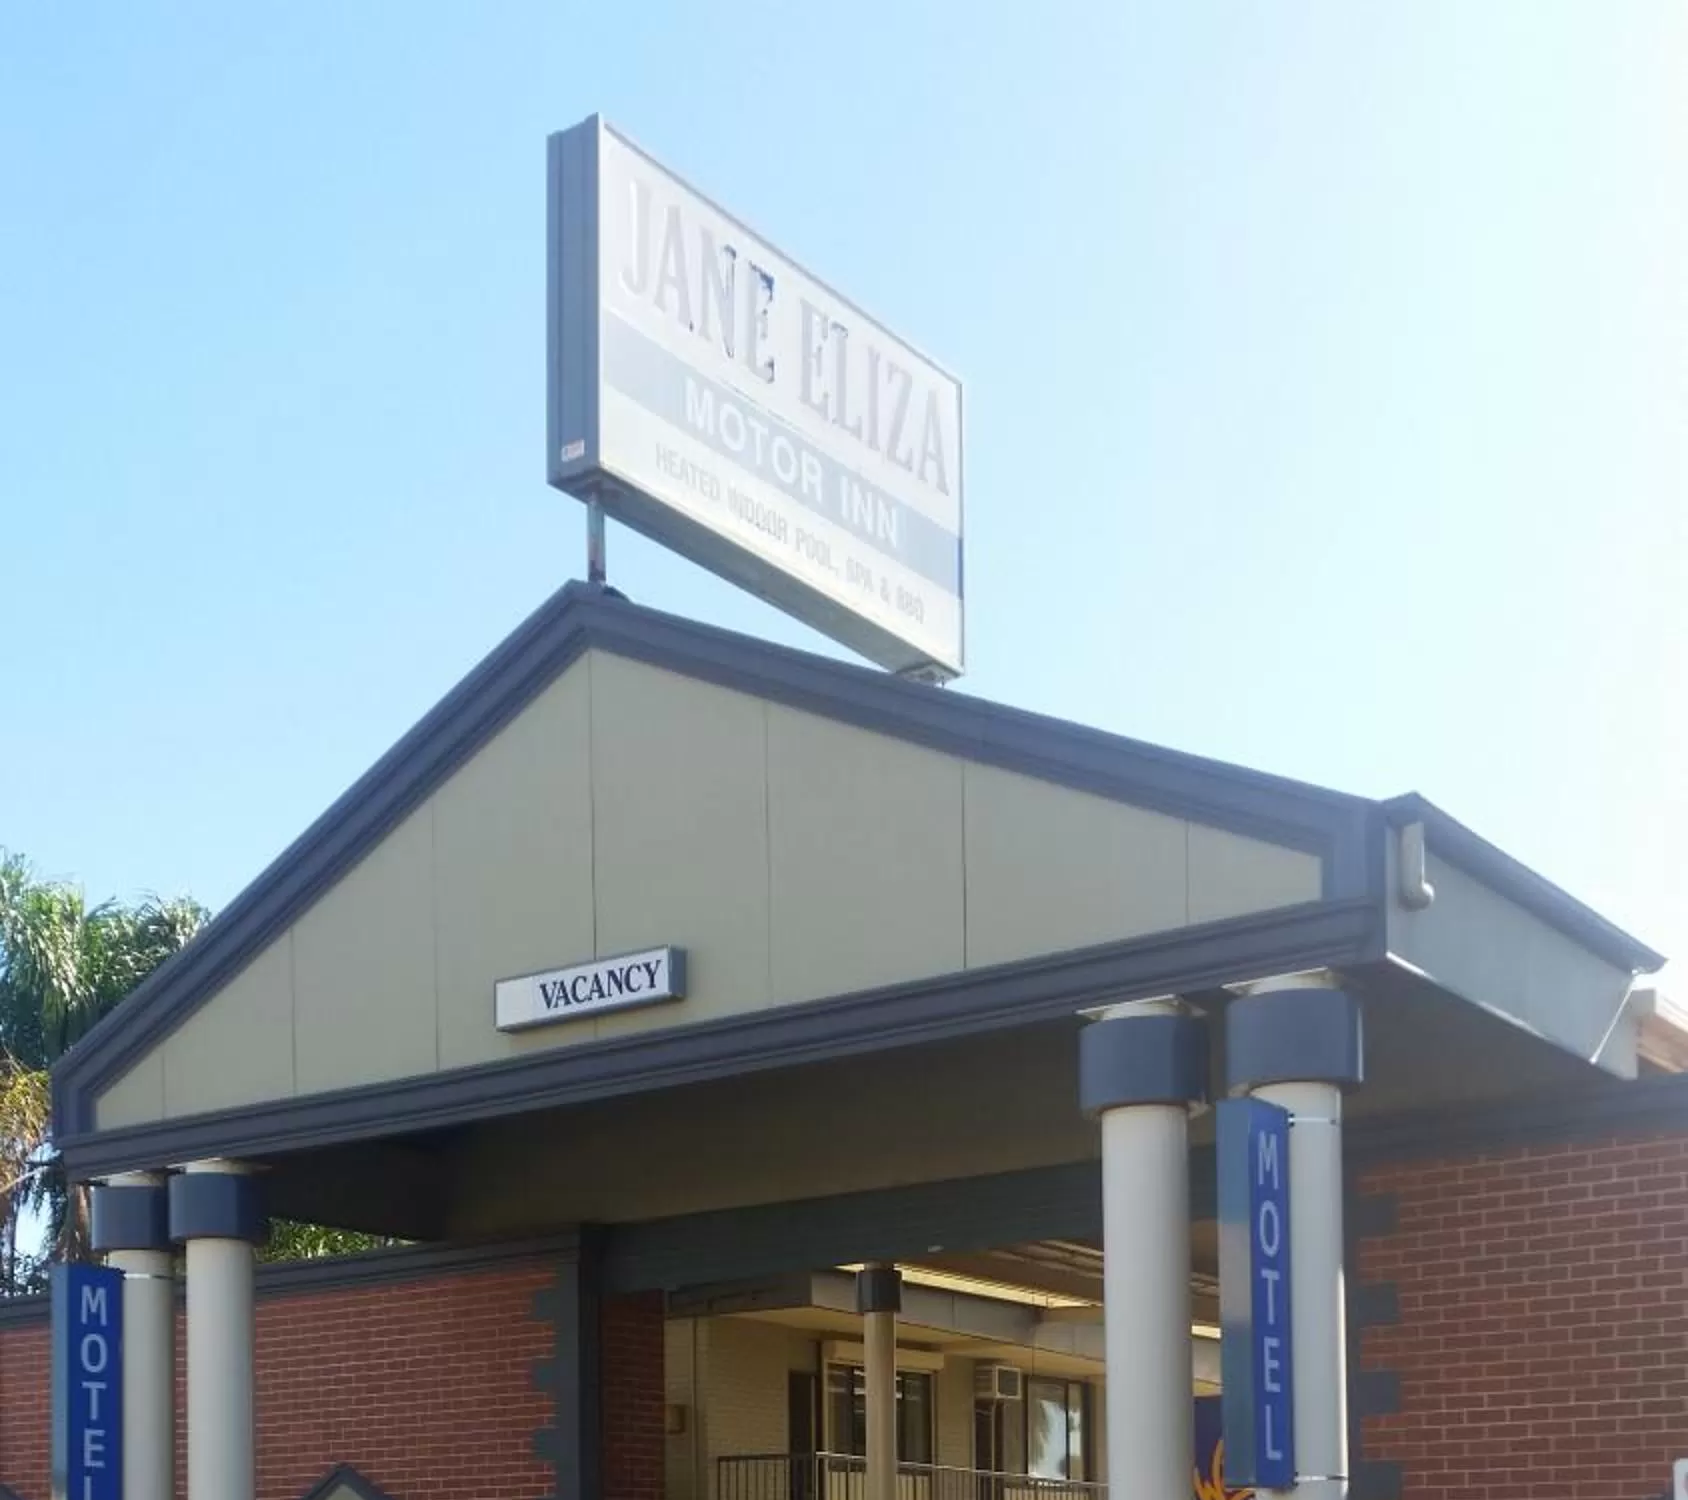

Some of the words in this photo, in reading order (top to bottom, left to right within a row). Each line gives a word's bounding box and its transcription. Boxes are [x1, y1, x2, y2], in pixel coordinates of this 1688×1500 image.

[620, 176, 776, 386] JANE
[798, 296, 949, 497] ELIZA
[655, 442, 721, 502] HEATED
[683, 376, 823, 505] MOTOR
[840, 475, 899, 549] INN
[538, 959, 662, 1010] VACANCY
[1256, 1129, 1283, 1462] MOTEL
